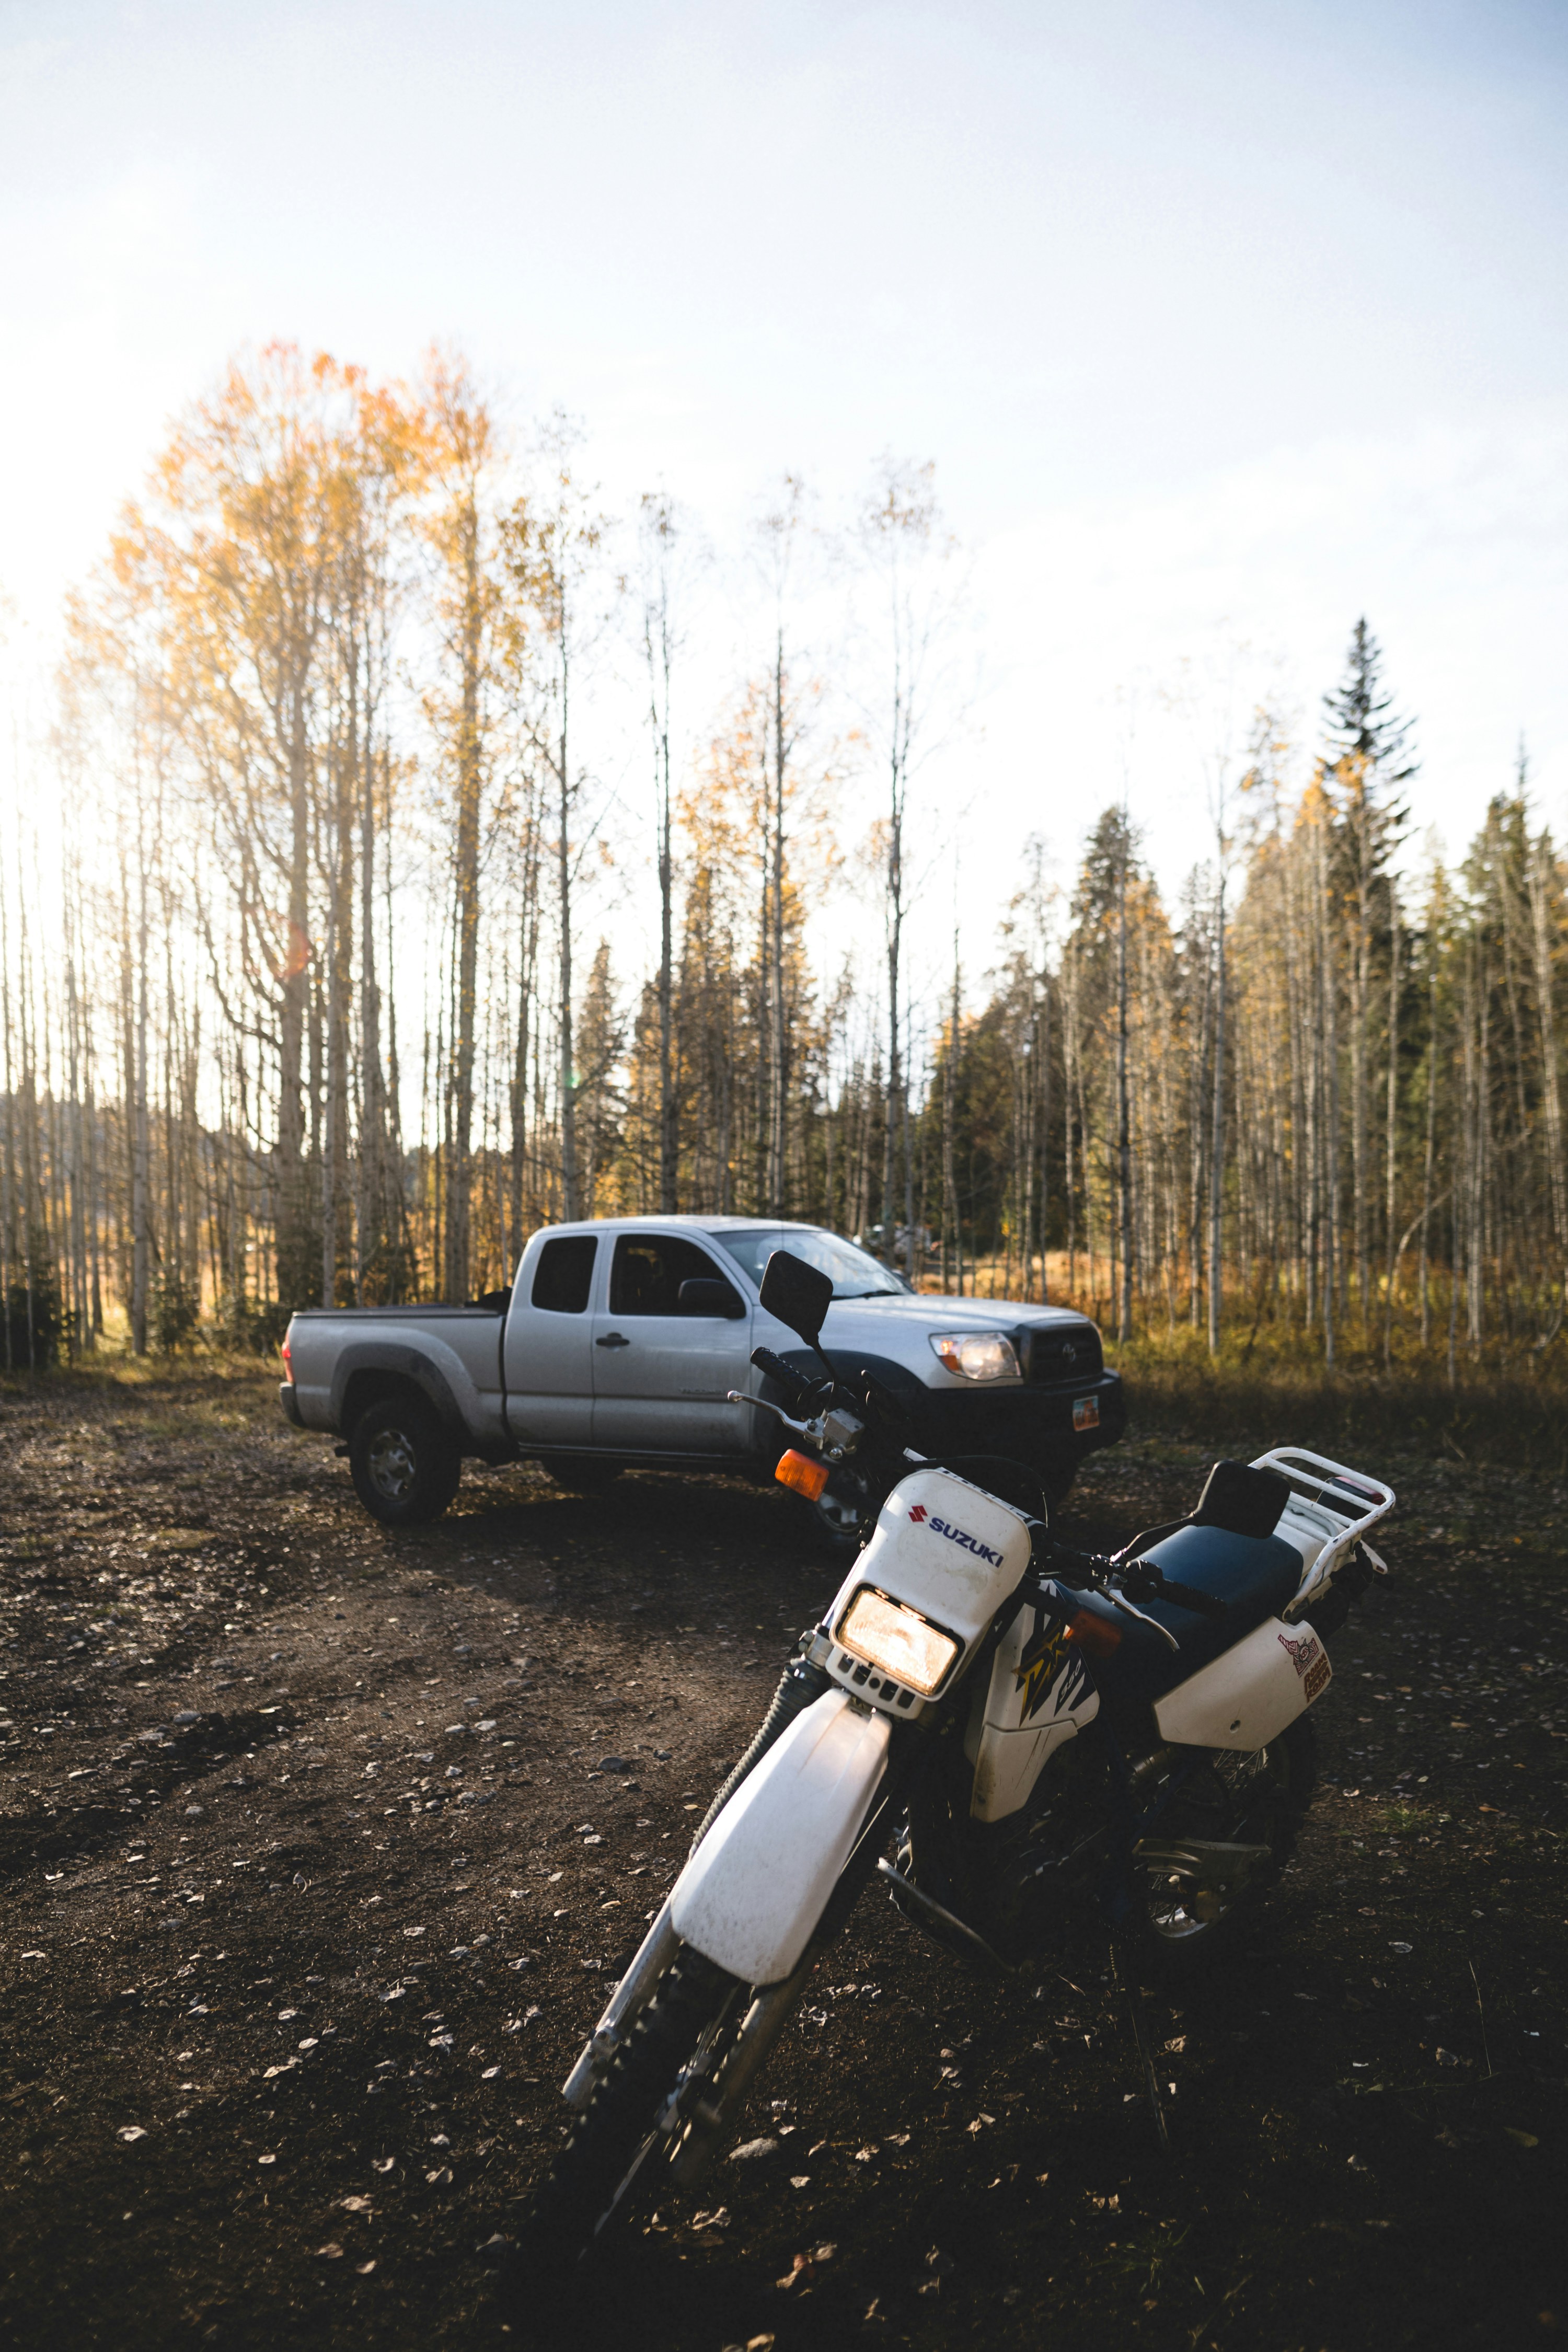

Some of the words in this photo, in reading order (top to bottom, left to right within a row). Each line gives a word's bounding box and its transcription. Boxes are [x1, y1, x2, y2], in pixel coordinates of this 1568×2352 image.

[929, 1517, 1004, 1568] SUZUKI
[1304, 1652, 1328, 1695] ROAM
[1307, 1666, 1331, 1703] ROAM
